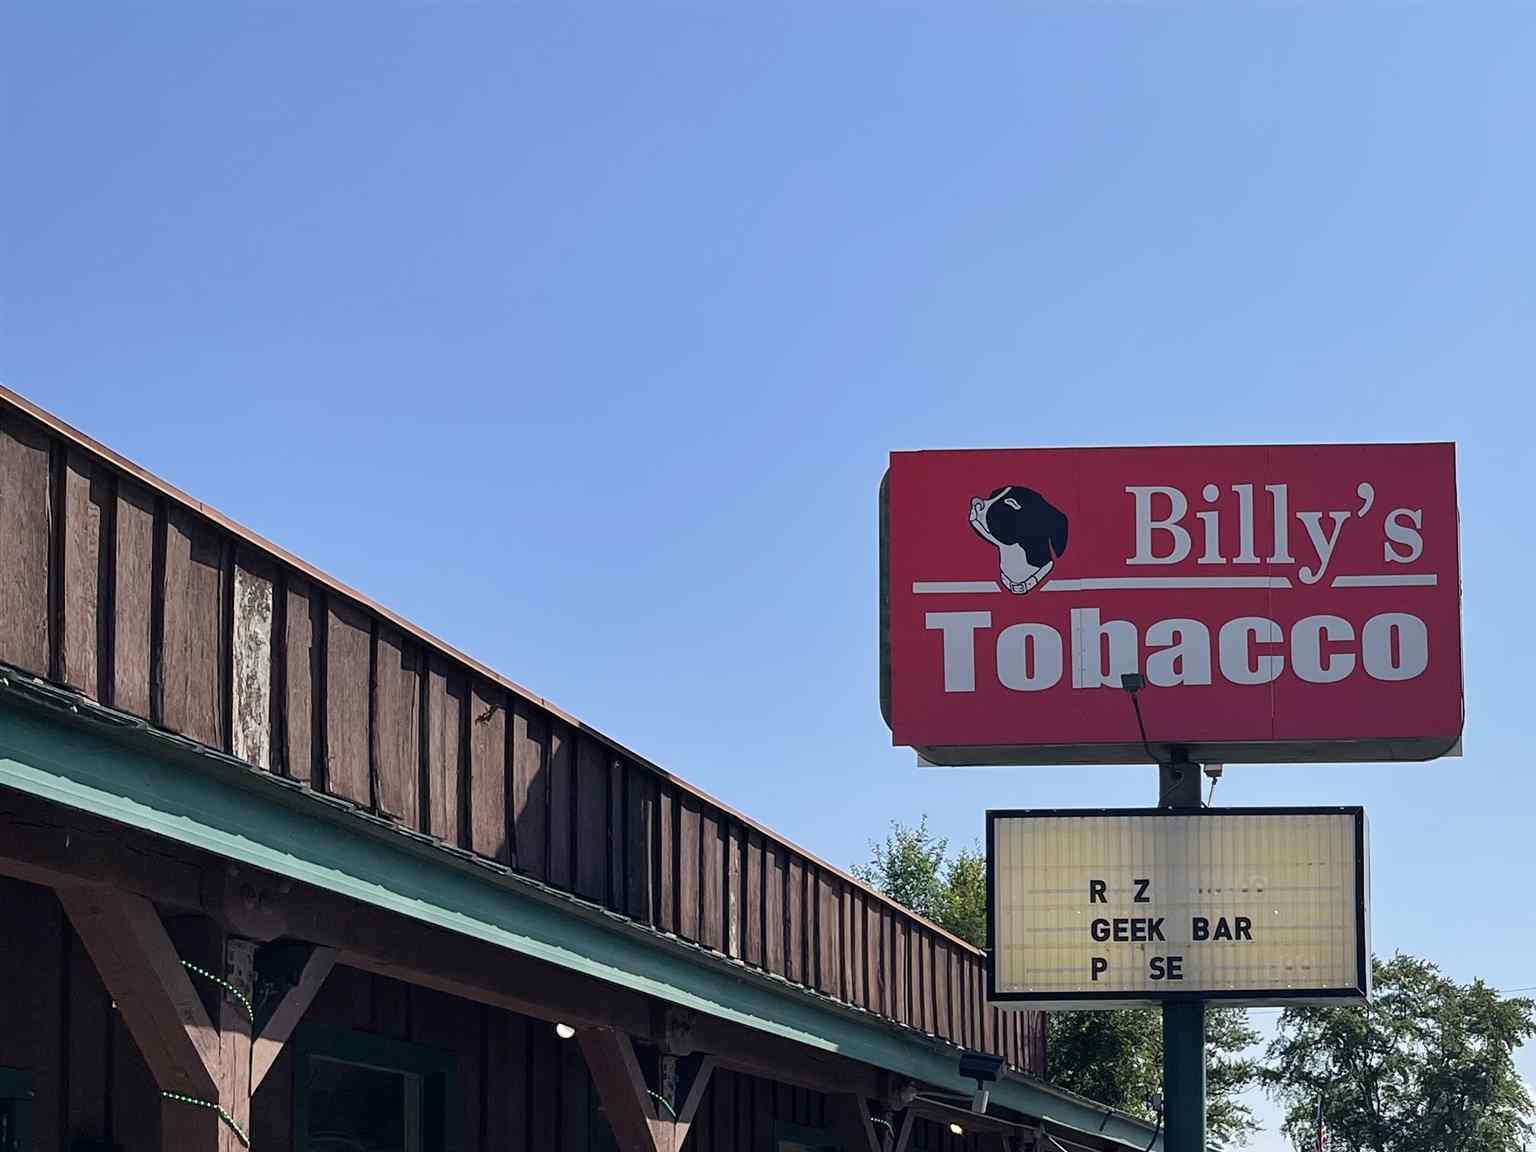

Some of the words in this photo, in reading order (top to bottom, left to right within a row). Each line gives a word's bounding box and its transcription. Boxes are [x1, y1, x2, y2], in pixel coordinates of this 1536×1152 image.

[1125, 482, 1424, 585] Billy's
[925, 607, 1429, 693] Tobacco
[1090, 917, 1166, 942] GEEK
[1192, 916, 1253, 941] BAR
